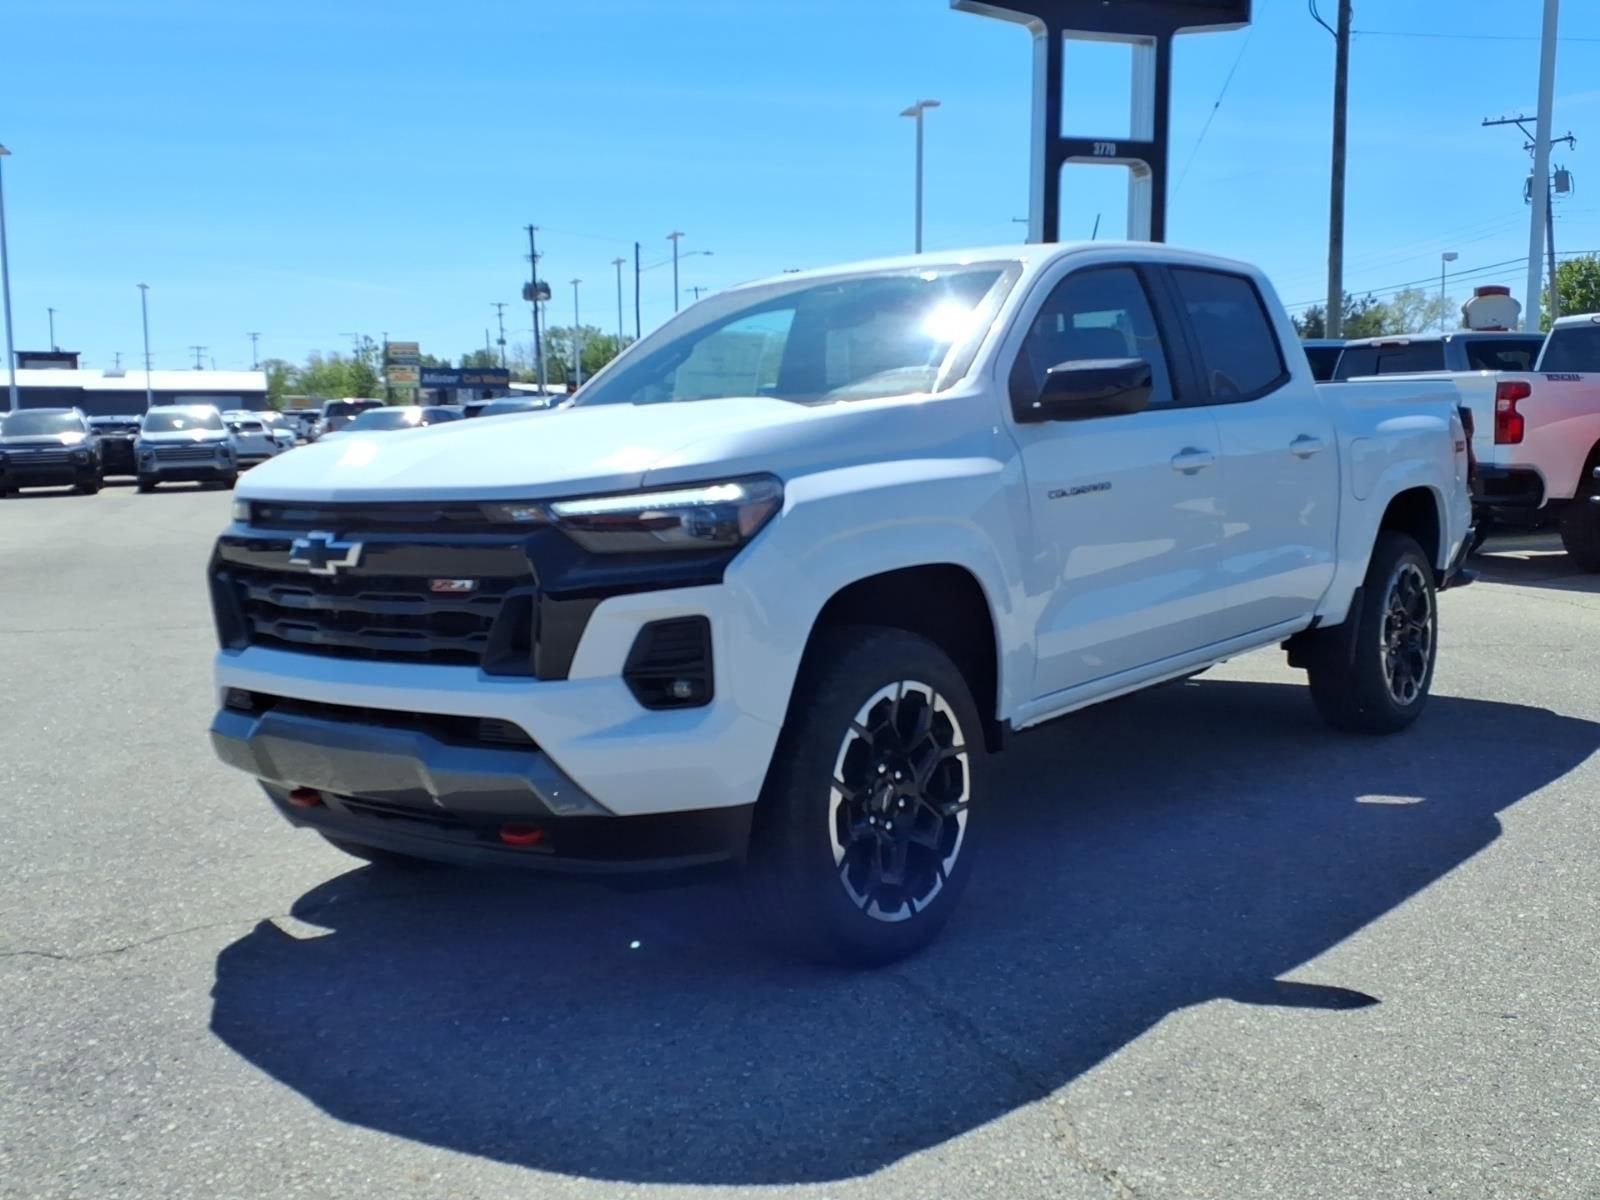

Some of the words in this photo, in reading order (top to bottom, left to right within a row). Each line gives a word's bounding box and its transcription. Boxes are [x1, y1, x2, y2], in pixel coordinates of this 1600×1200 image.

[1093, 142, 1116, 156] 3770
[422, 373, 459, 384] Mister
[1048, 481, 1112, 500] COLORADO
